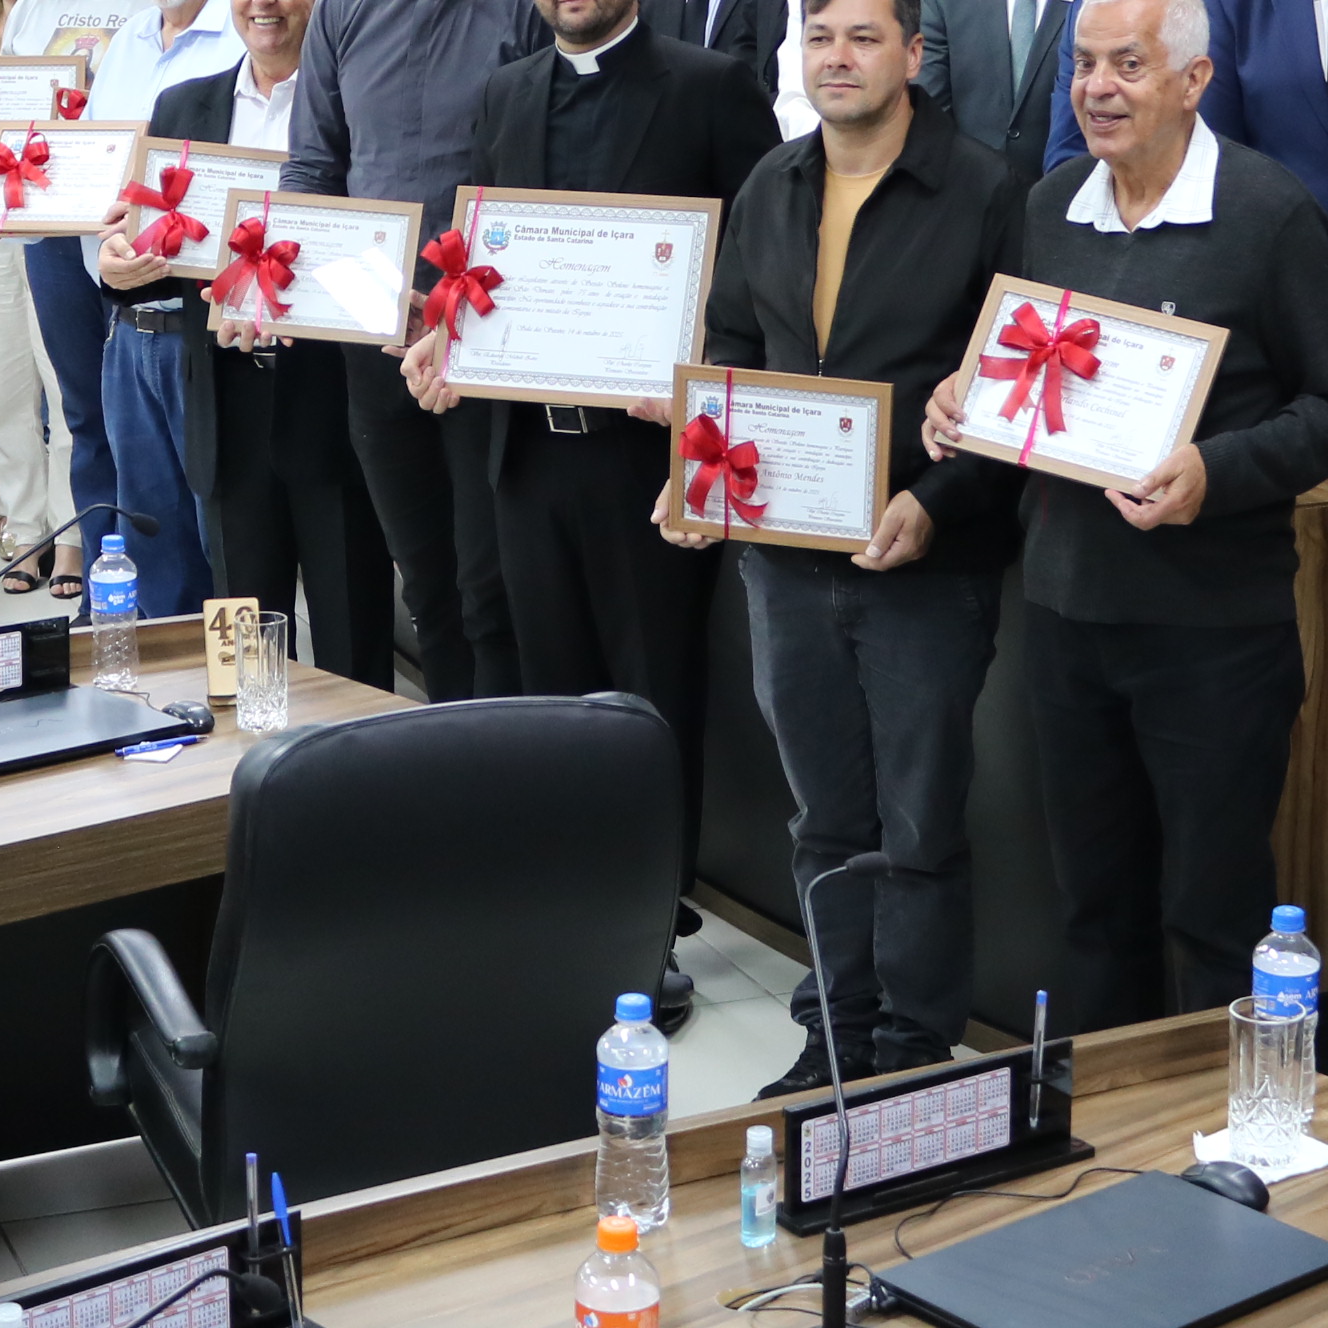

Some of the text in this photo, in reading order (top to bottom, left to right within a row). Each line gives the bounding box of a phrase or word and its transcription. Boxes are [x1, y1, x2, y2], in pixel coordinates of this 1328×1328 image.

[58, 13, 101, 28] Cristo
[207, 167, 237, 177] Municipal
[273, 217, 298, 226] Câmara
[299, 218, 331, 229] Municipal
[513, 234, 536, 242] Estado
[546, 235, 565, 243] Santa
[566, 236, 594, 245] Catarina
[514, 224, 635, 241] Câmara Municipal de Içara
[538, 257, 612, 274] Homenagem
[1111, 336, 1122, 345] de
[1123, 338, 1145, 351] Içara
[730, 401, 822, 417] âmara Municipal de Içara
[1060, 395, 1090, 411] rlando
[747, 423, 806, 438] Homenagem
[760, 468, 824, 483] Antônio Mendes
[803, 1141, 812, 1199] 2025
